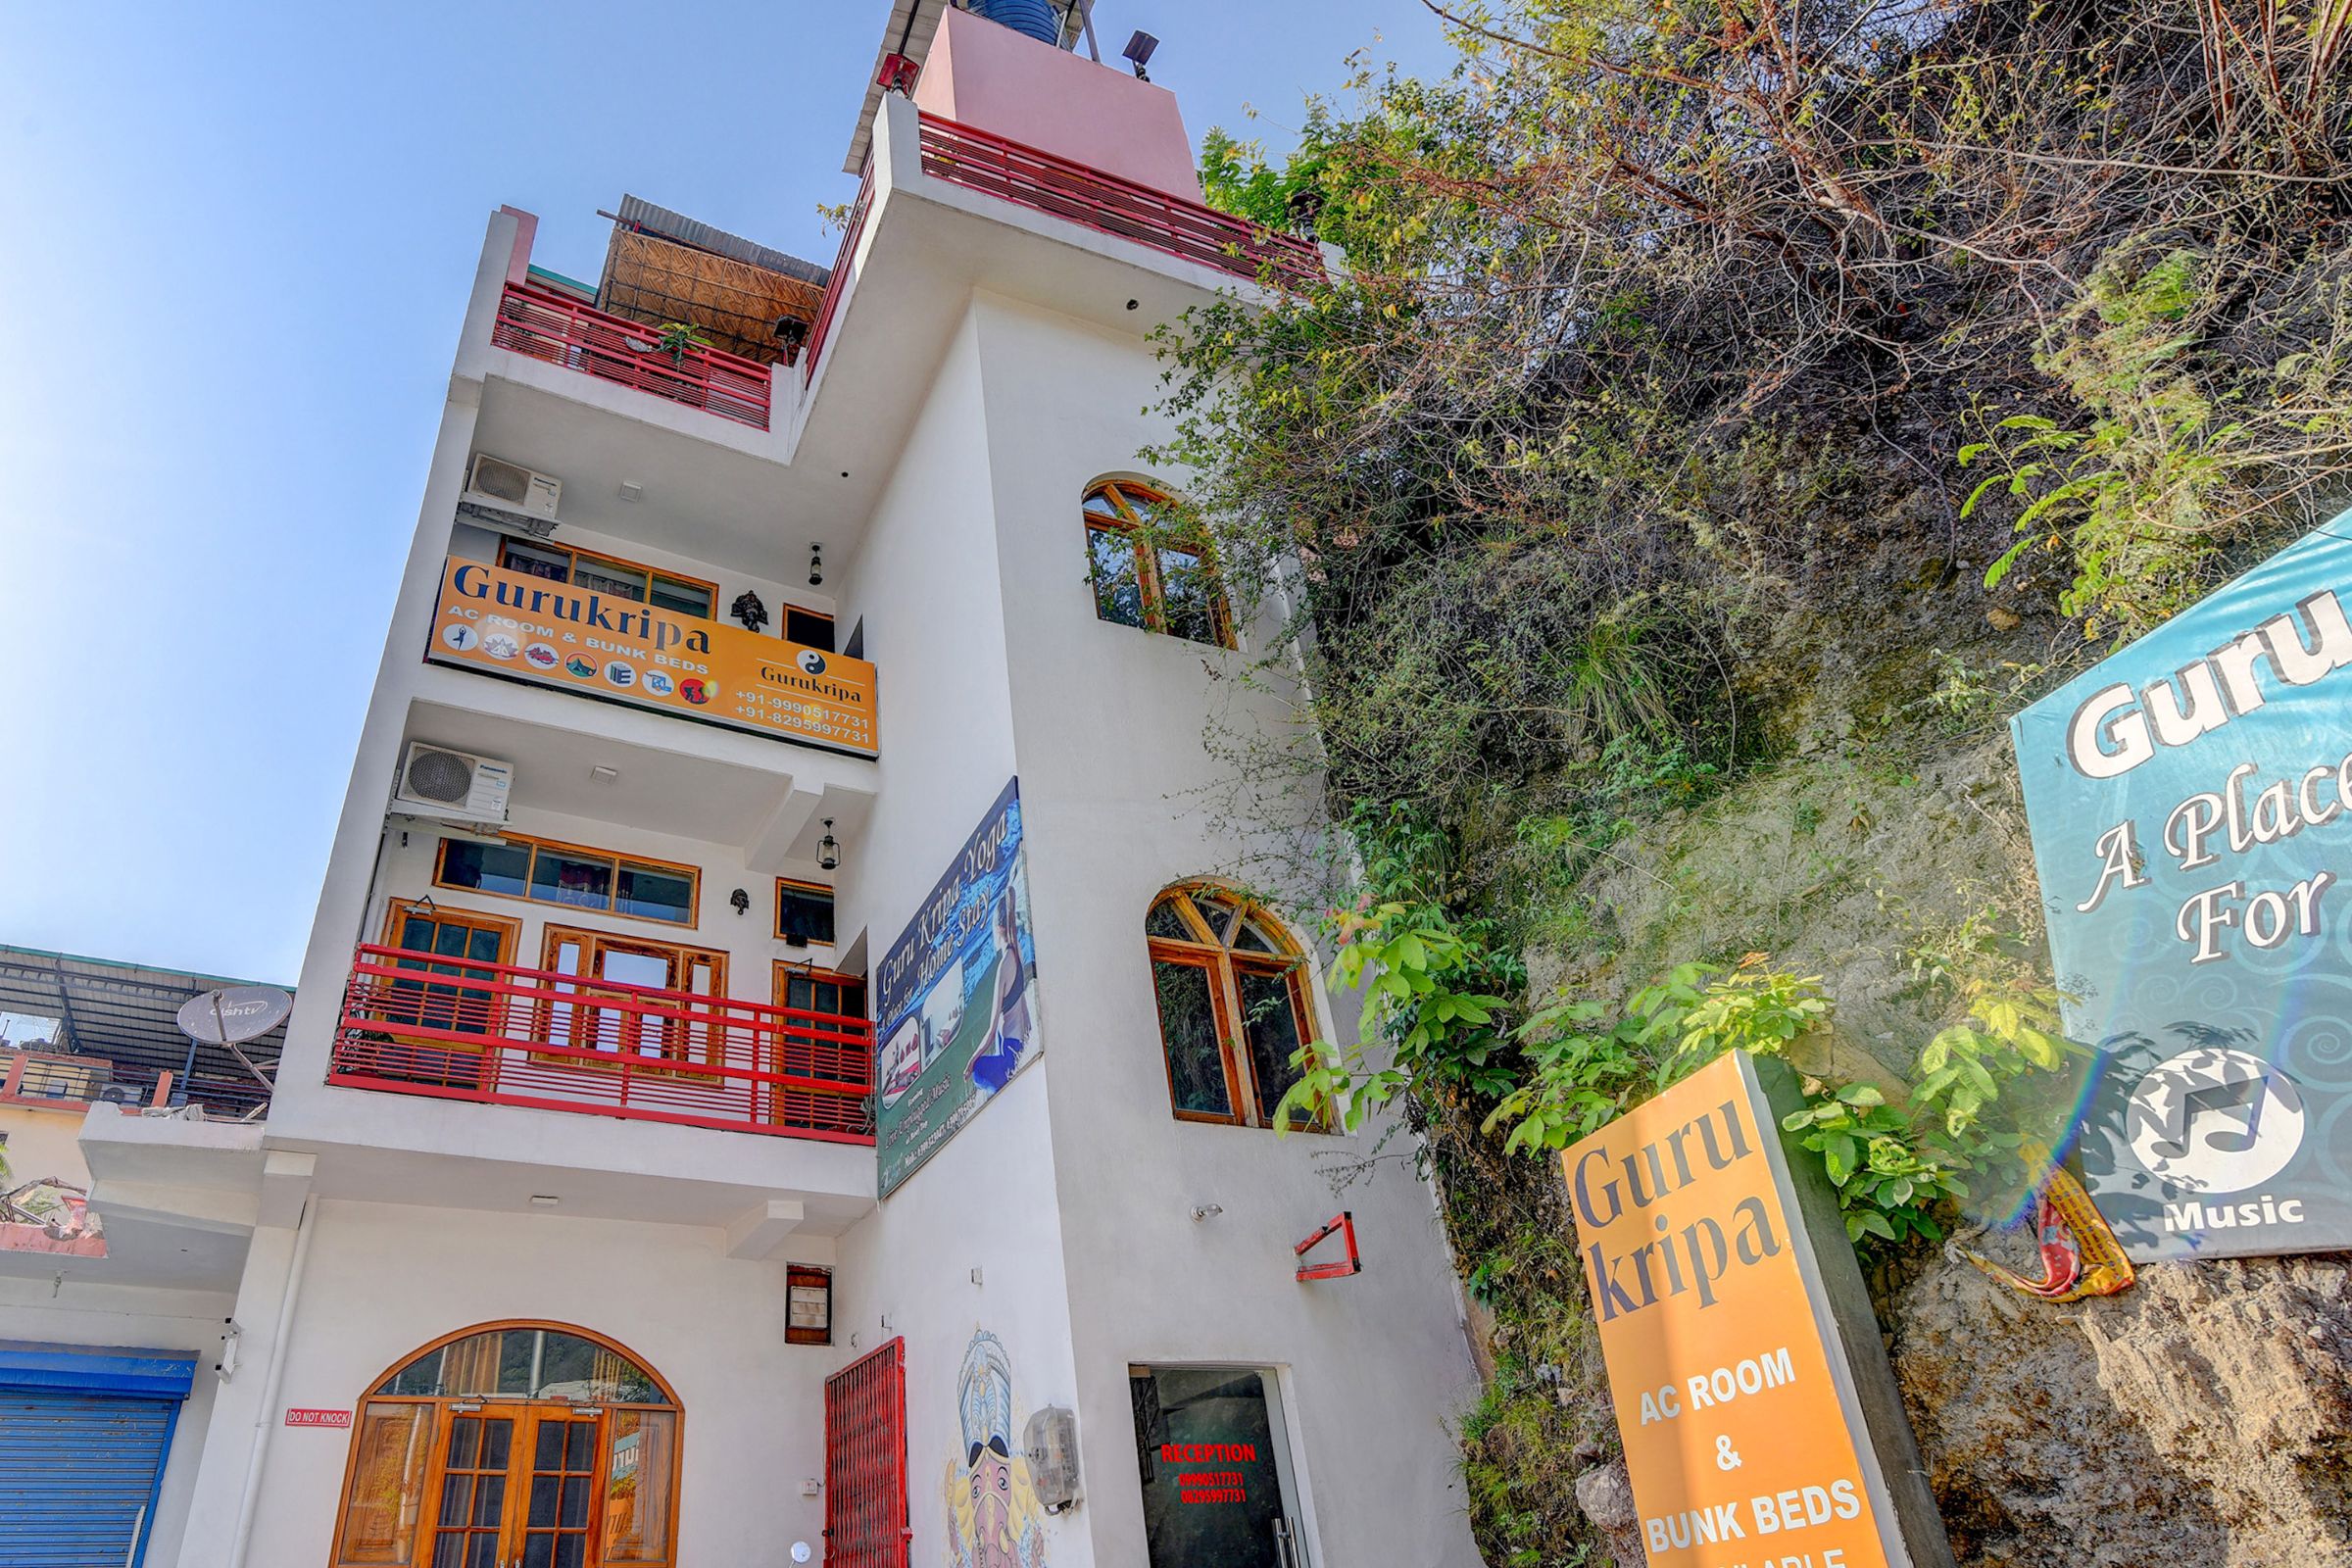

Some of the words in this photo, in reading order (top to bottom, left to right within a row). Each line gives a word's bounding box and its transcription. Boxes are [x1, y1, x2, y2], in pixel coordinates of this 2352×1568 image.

[448, 606, 478, 620] AC
[486, 614, 554, 637] ROOM
[563, 631, 577, 644] &
[586, 637, 646, 661] BUNK
[654, 654, 709, 675] BEDS
[454, 564, 710, 655] Gurukripa
[760, 666, 861, 703] Gurukripa
[2068, 590, 2352, 779] Guru
[2077, 819, 2151, 912] A
[883, 934, 915, 1007] Guru
[917, 872, 960, 948] Kripa
[964, 810, 1006, 885] Yoga
[917, 933, 955, 997] Home
[957, 885, 992, 948] Stay
[2176, 871, 2335, 964] For
[1575, 1099, 1753, 1229] Guru
[2164, 1195, 2304, 1232] Music
[1588, 1195, 1782, 1323] kripa
[289, 1411, 302, 1422] DO
[302, 1412, 319, 1423] NOT
[320, 1412, 348, 1424] KNOCK
[1640, 1385, 1681, 1427] AC
[1687, 1347, 1796, 1412] ROOM
[1160, 1444, 1256, 1463] RECEPTION
[1715, 1434, 1742, 1471] &
[1645, 1501, 1746, 1553] BUNK
[1752, 1478, 1861, 1536] BEDS
